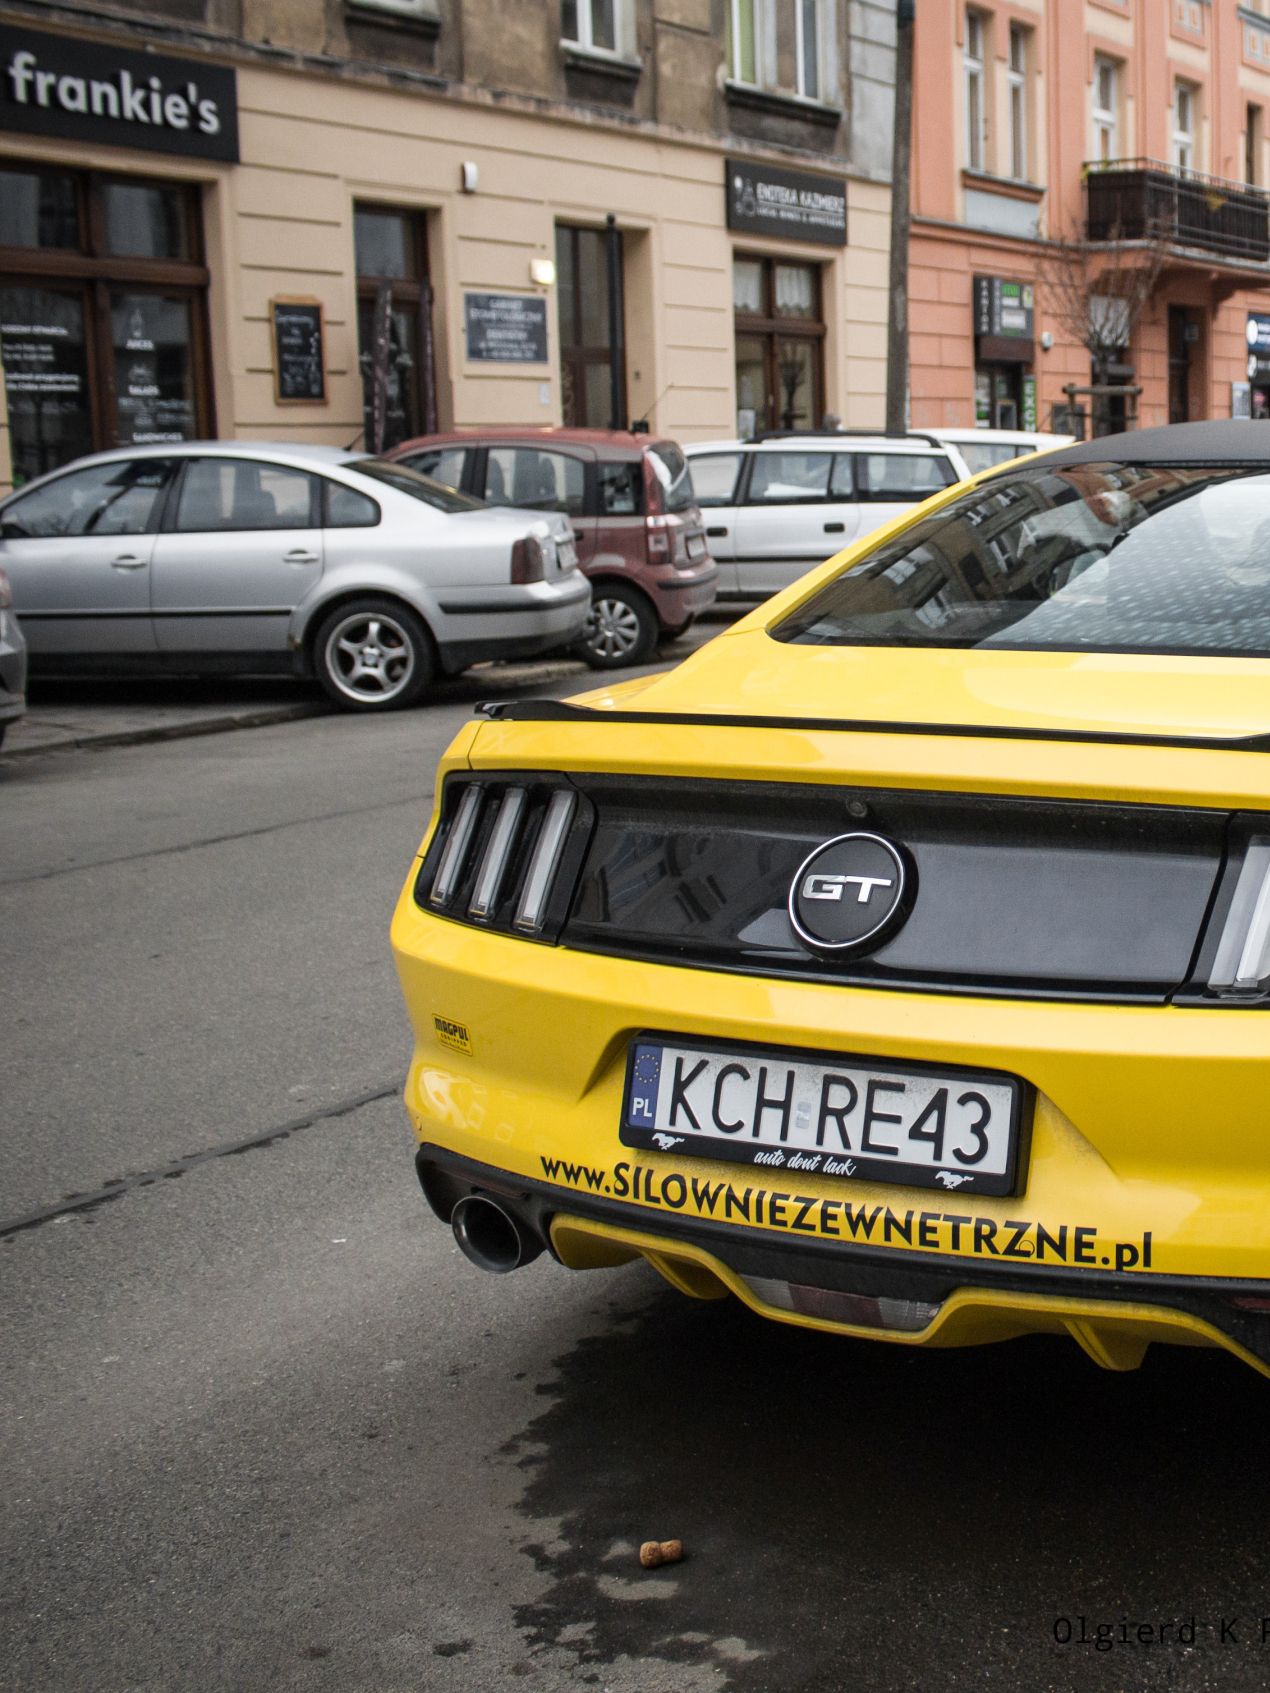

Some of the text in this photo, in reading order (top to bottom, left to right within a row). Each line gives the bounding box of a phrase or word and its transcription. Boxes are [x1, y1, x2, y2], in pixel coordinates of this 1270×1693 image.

[8, 51, 221, 135] frankie's
[802, 874, 892, 903] GT
[434, 1017, 469, 1042] MAGPUL
[632, 1097, 652, 1117] PL
[669, 1056, 992, 1165] KCH RE43
[753, 1149, 786, 1166] auto
[540, 1156, 1152, 1271] www.SILOWNIEZEWNETRZNE.pl
